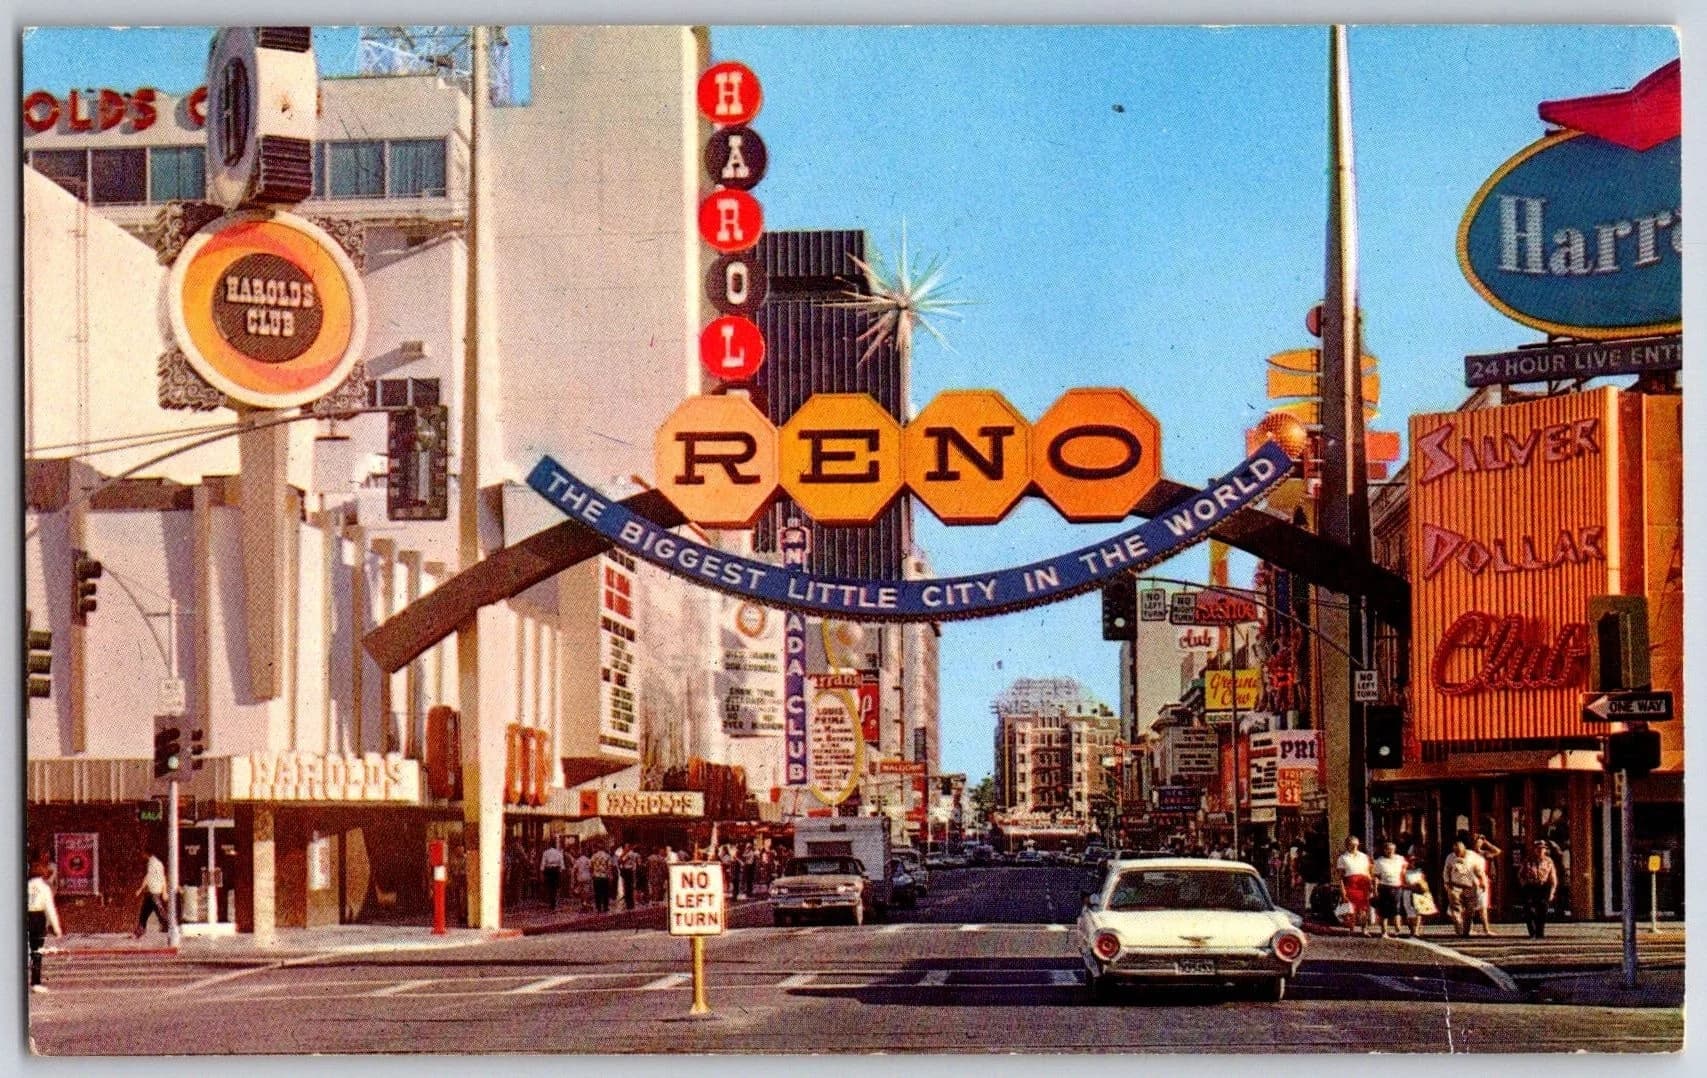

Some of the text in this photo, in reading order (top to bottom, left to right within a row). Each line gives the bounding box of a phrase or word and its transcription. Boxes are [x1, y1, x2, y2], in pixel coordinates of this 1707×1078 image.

[713, 71, 753, 396] HAROL
[227, 275, 315, 309] HAROLDS
[247, 307, 295, 337] CLUB
[1471, 361, 1500, 380] 24
[1505, 353, 1567, 377] HOUR
[1573, 349, 1622, 371] LIVE
[674, 423, 1142, 486] RENO
[1416, 417, 1600, 485] SILVER
[547, 470, 604, 524] THE
[618, 520, 766, 591] BIGGEST
[787, 577, 900, 608] LITTLE
[921, 579, 998, 608] CITY
[1023, 565, 1060, 594] IN
[1078, 534, 1149, 576] THE
[1164, 455, 1276, 538] WORLD
[1421, 521, 1607, 581] DOLLAR
[1360, 672, 1373, 681] NO
[1609, 700, 1664, 712] ONE WAY
[786, 694, 805, 782] CLUB
[681, 872, 708, 889] NO
[675, 894, 715, 908] LEFT
[674, 911, 719, 926] TURN
